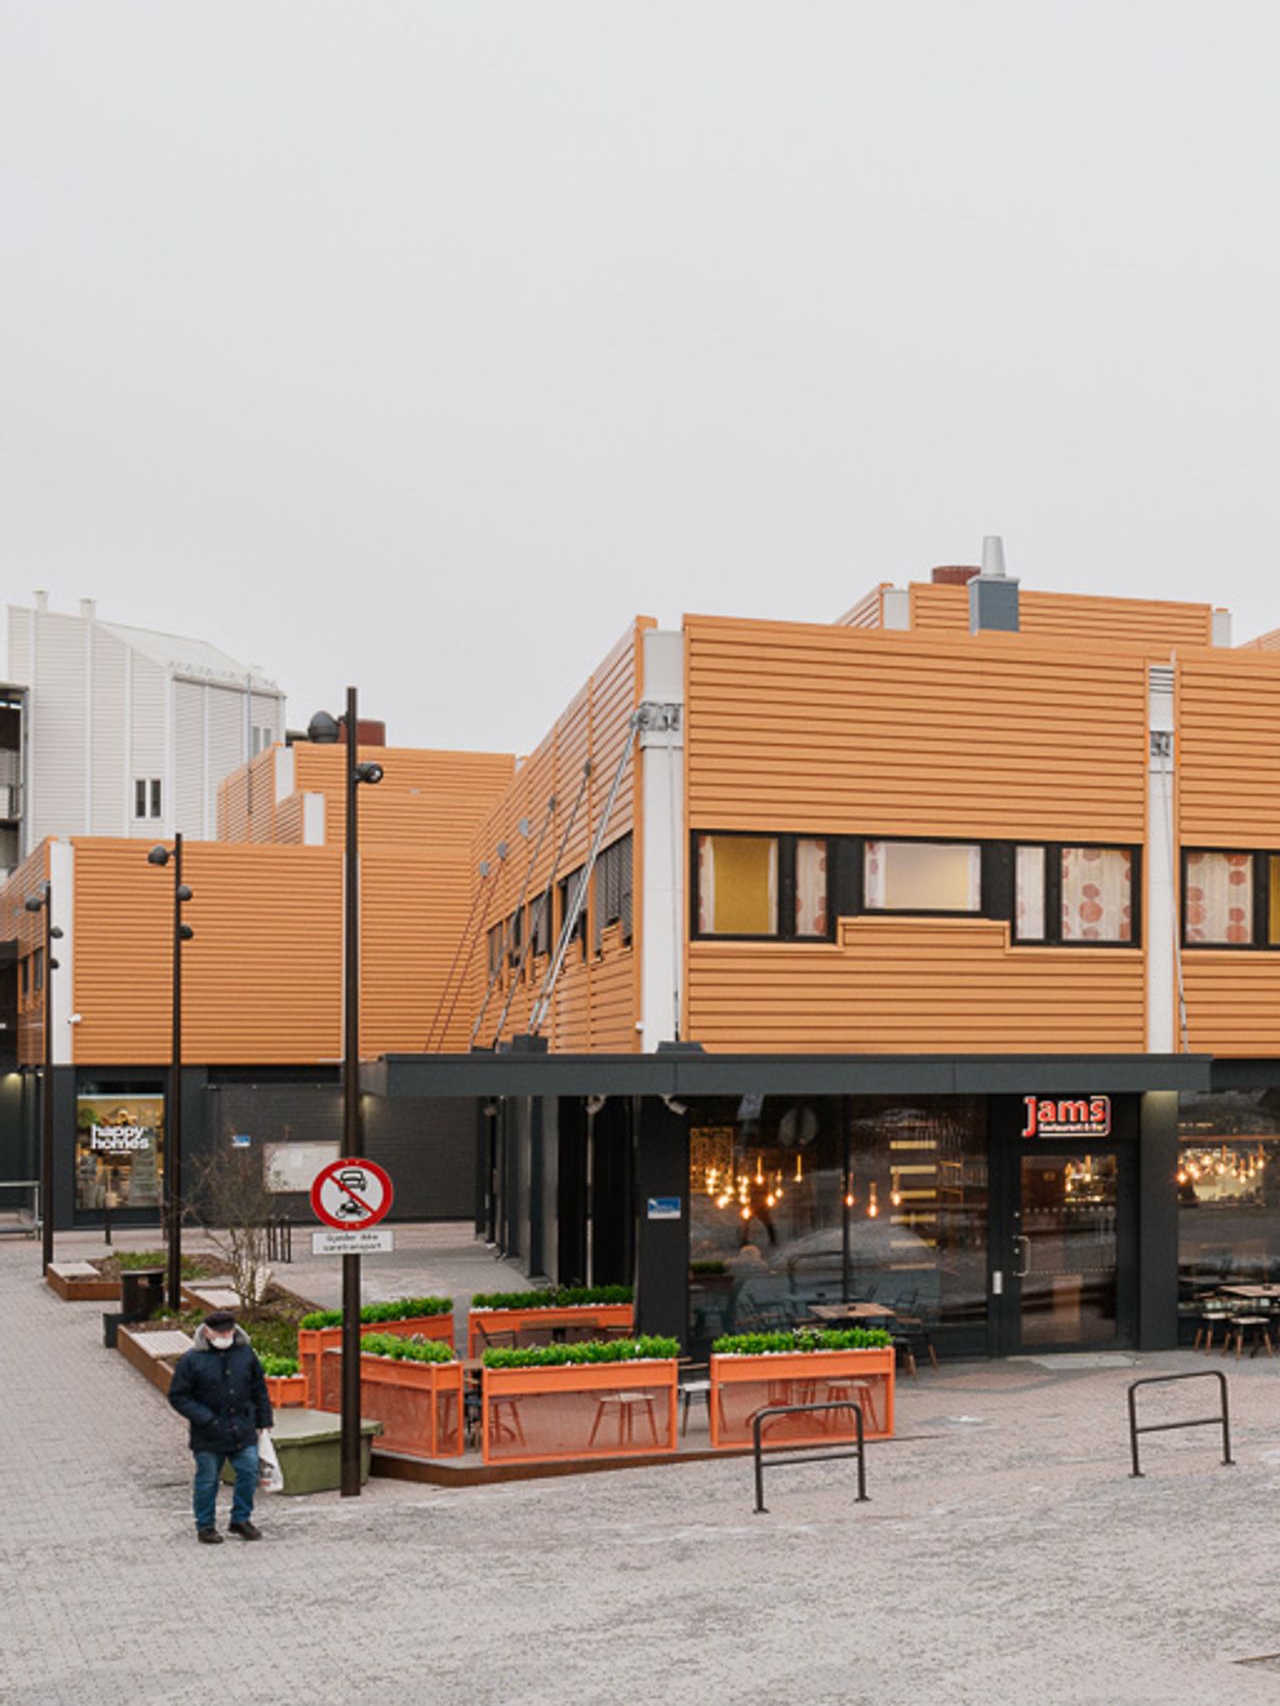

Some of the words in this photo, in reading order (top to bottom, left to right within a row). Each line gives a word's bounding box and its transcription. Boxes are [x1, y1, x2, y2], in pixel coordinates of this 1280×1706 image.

[1022, 1095, 1106, 1138] Jams
[91, 1123, 146, 1141] happy
[91, 1136, 149, 1150] homes
